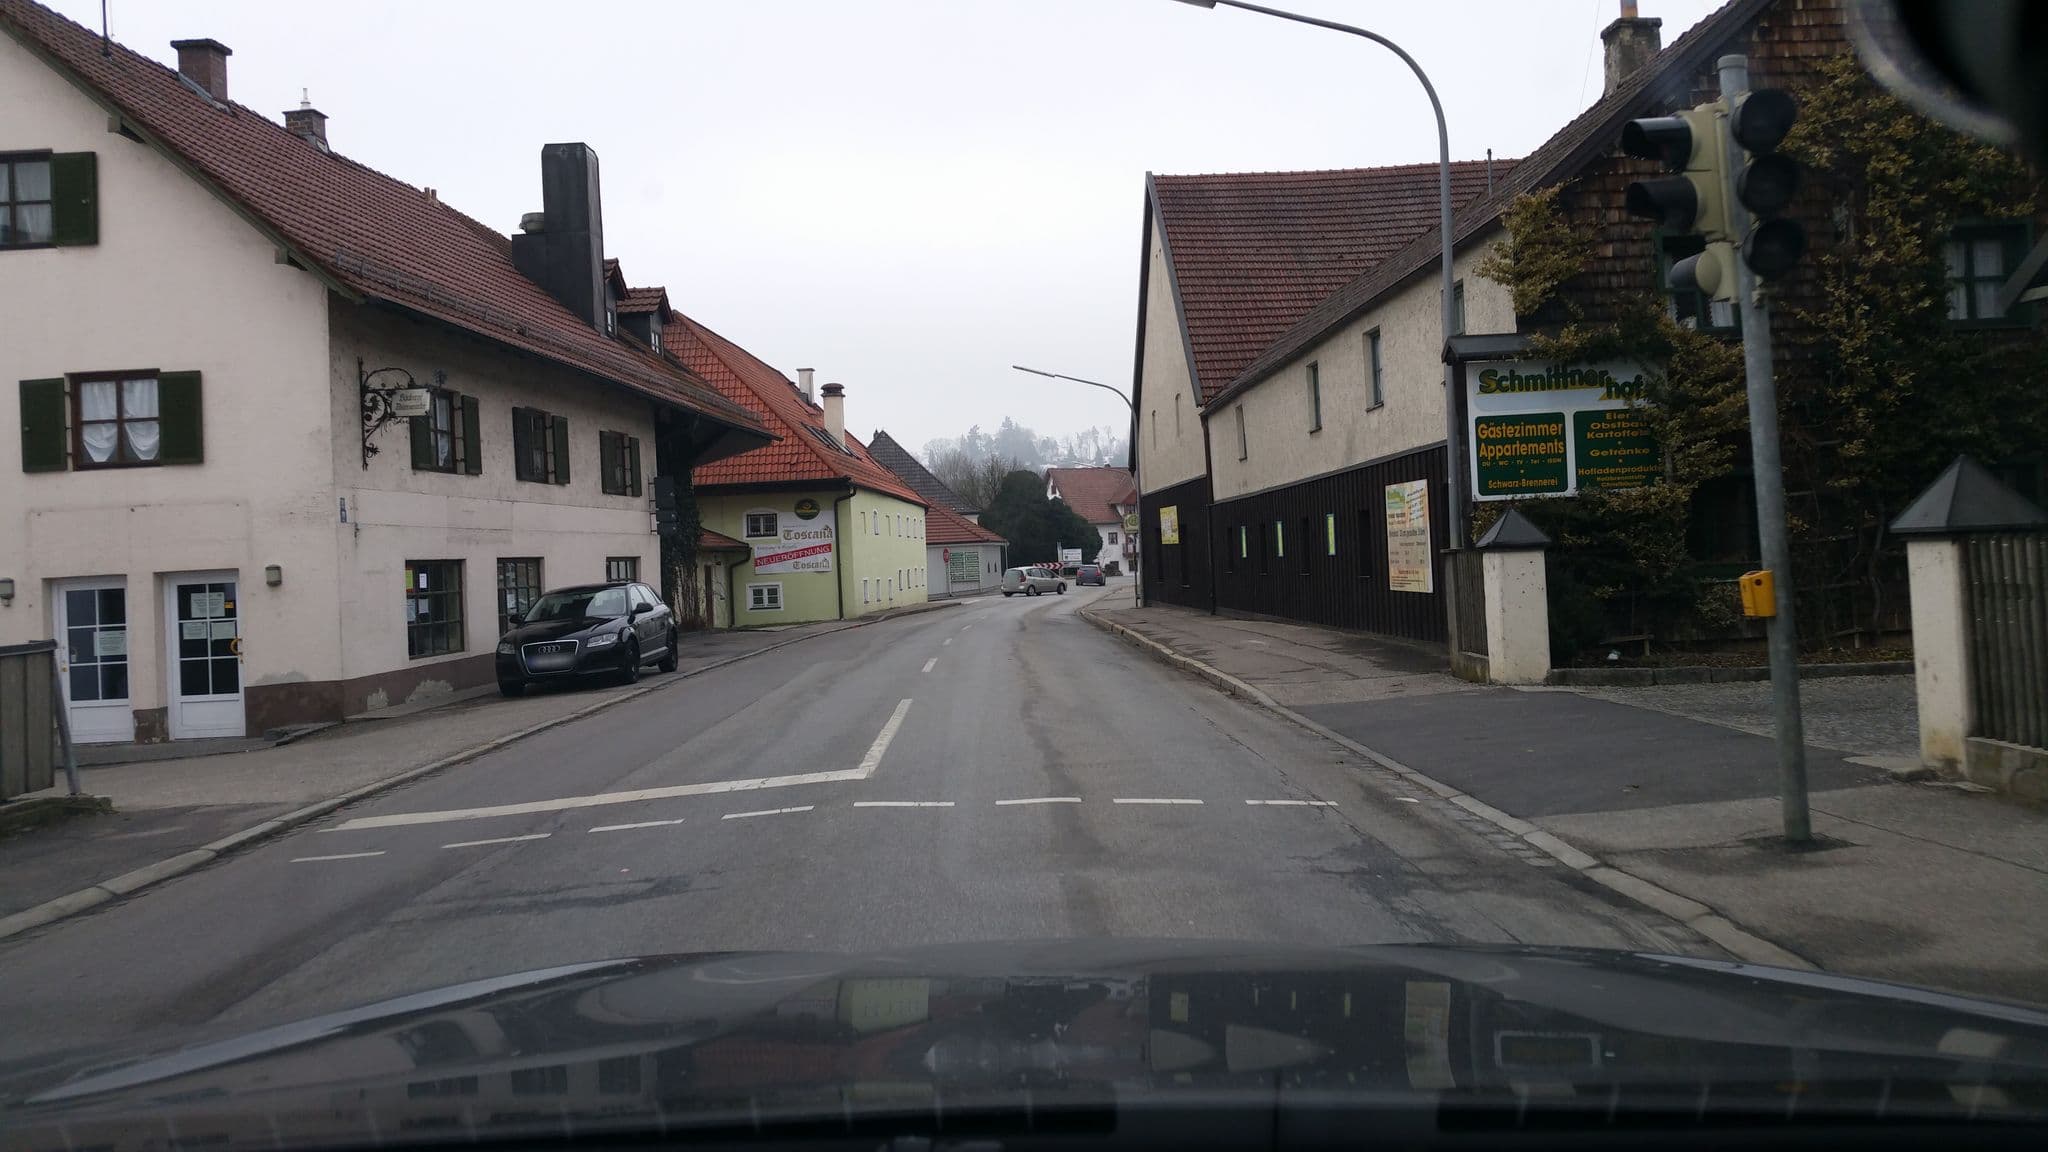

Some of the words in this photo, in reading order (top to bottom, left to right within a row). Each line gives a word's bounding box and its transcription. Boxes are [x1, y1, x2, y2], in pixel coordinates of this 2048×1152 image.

[1605, 412, 1632, 420] Eier
[1478, 422, 1563, 439] Gästezimmer
[1590, 421, 1648, 430] Obstbau
[1479, 439, 1565, 460] Appartements
[1589, 447, 1650, 457] Getränke
[1578, 465, 1662, 476] Hofladenprodukt
[1488, 477, 1558, 489] Schwarz-Brennerei
[783, 529, 833, 541] Toscana
[793, 560, 830, 569] Toscana
